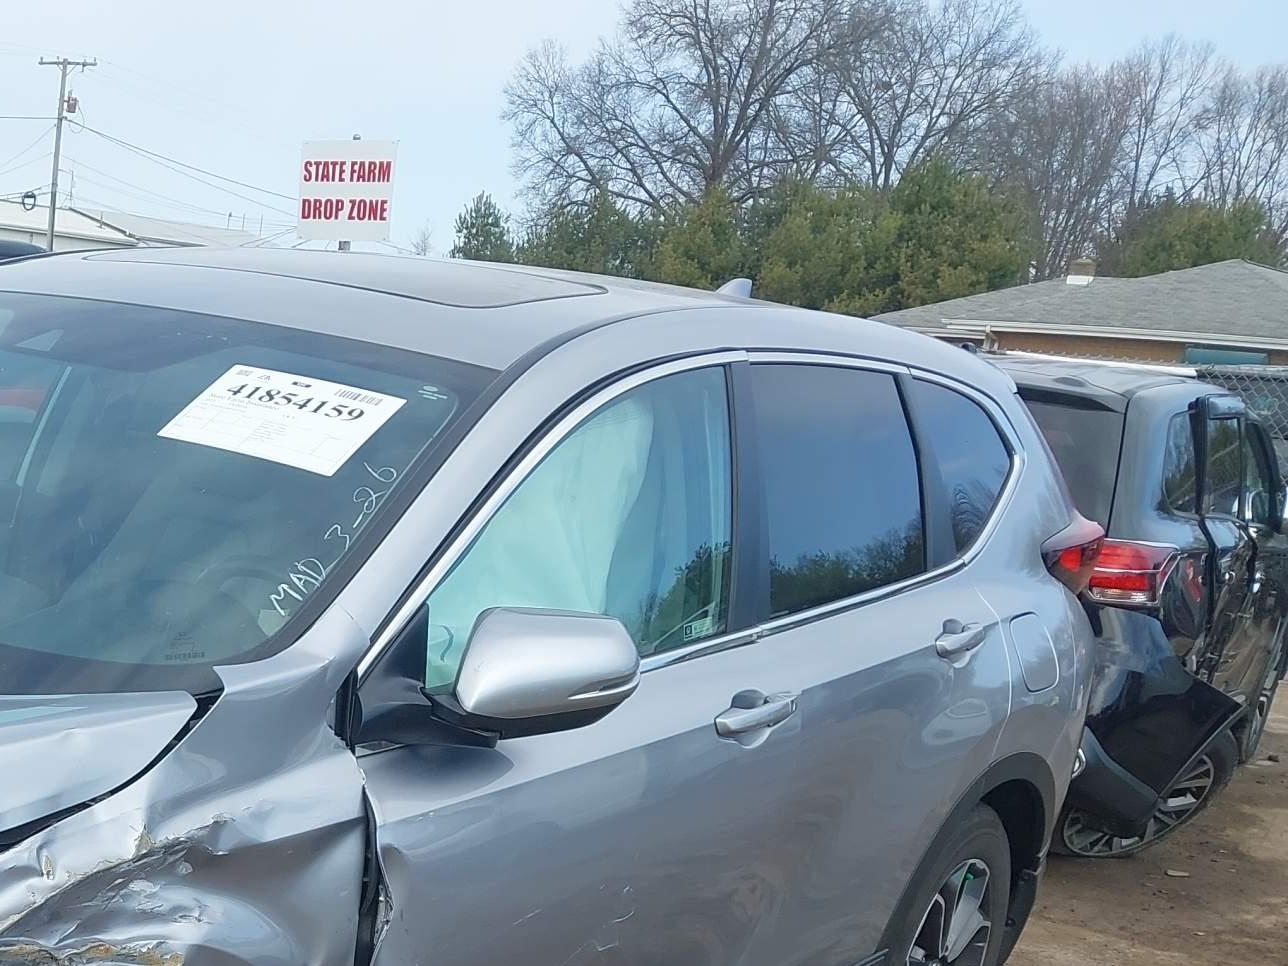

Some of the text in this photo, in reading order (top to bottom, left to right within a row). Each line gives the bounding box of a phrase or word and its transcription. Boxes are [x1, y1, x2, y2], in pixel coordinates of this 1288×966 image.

[303, 160, 392, 182] STATE FARM
[301, 198, 388, 221] DROP ZONE
[227, 383, 365, 421] 41854159
[270, 558, 326, 616] MAD
